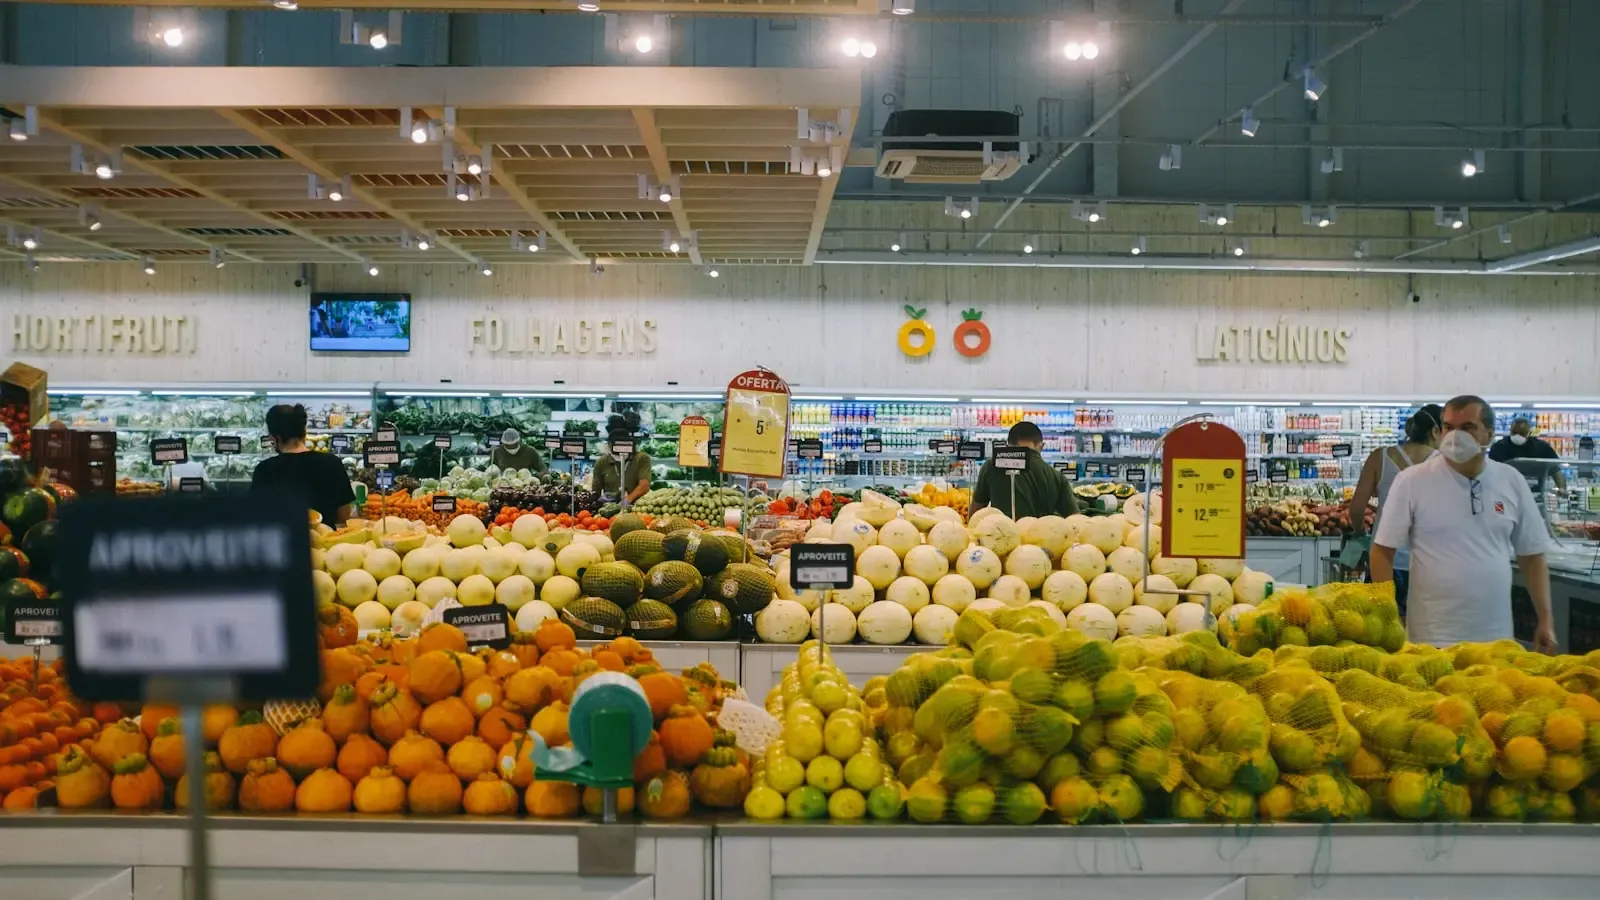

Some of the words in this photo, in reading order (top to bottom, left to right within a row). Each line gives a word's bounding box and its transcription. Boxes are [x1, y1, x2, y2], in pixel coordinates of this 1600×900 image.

[11, 314, 198, 354] HORTIFRUTI
[467, 315, 657, 354] FOLHAGENS
[1196, 315, 1353, 363] LATICÍNIOS
[736, 375, 785, 391] OFERTA
[87, 526, 287, 573] APROVEITE
[797, 551, 848, 561] APROVEITE
[13, 607, 61, 616] APROVEIT
[451, 612, 502, 625] APROVEITE
